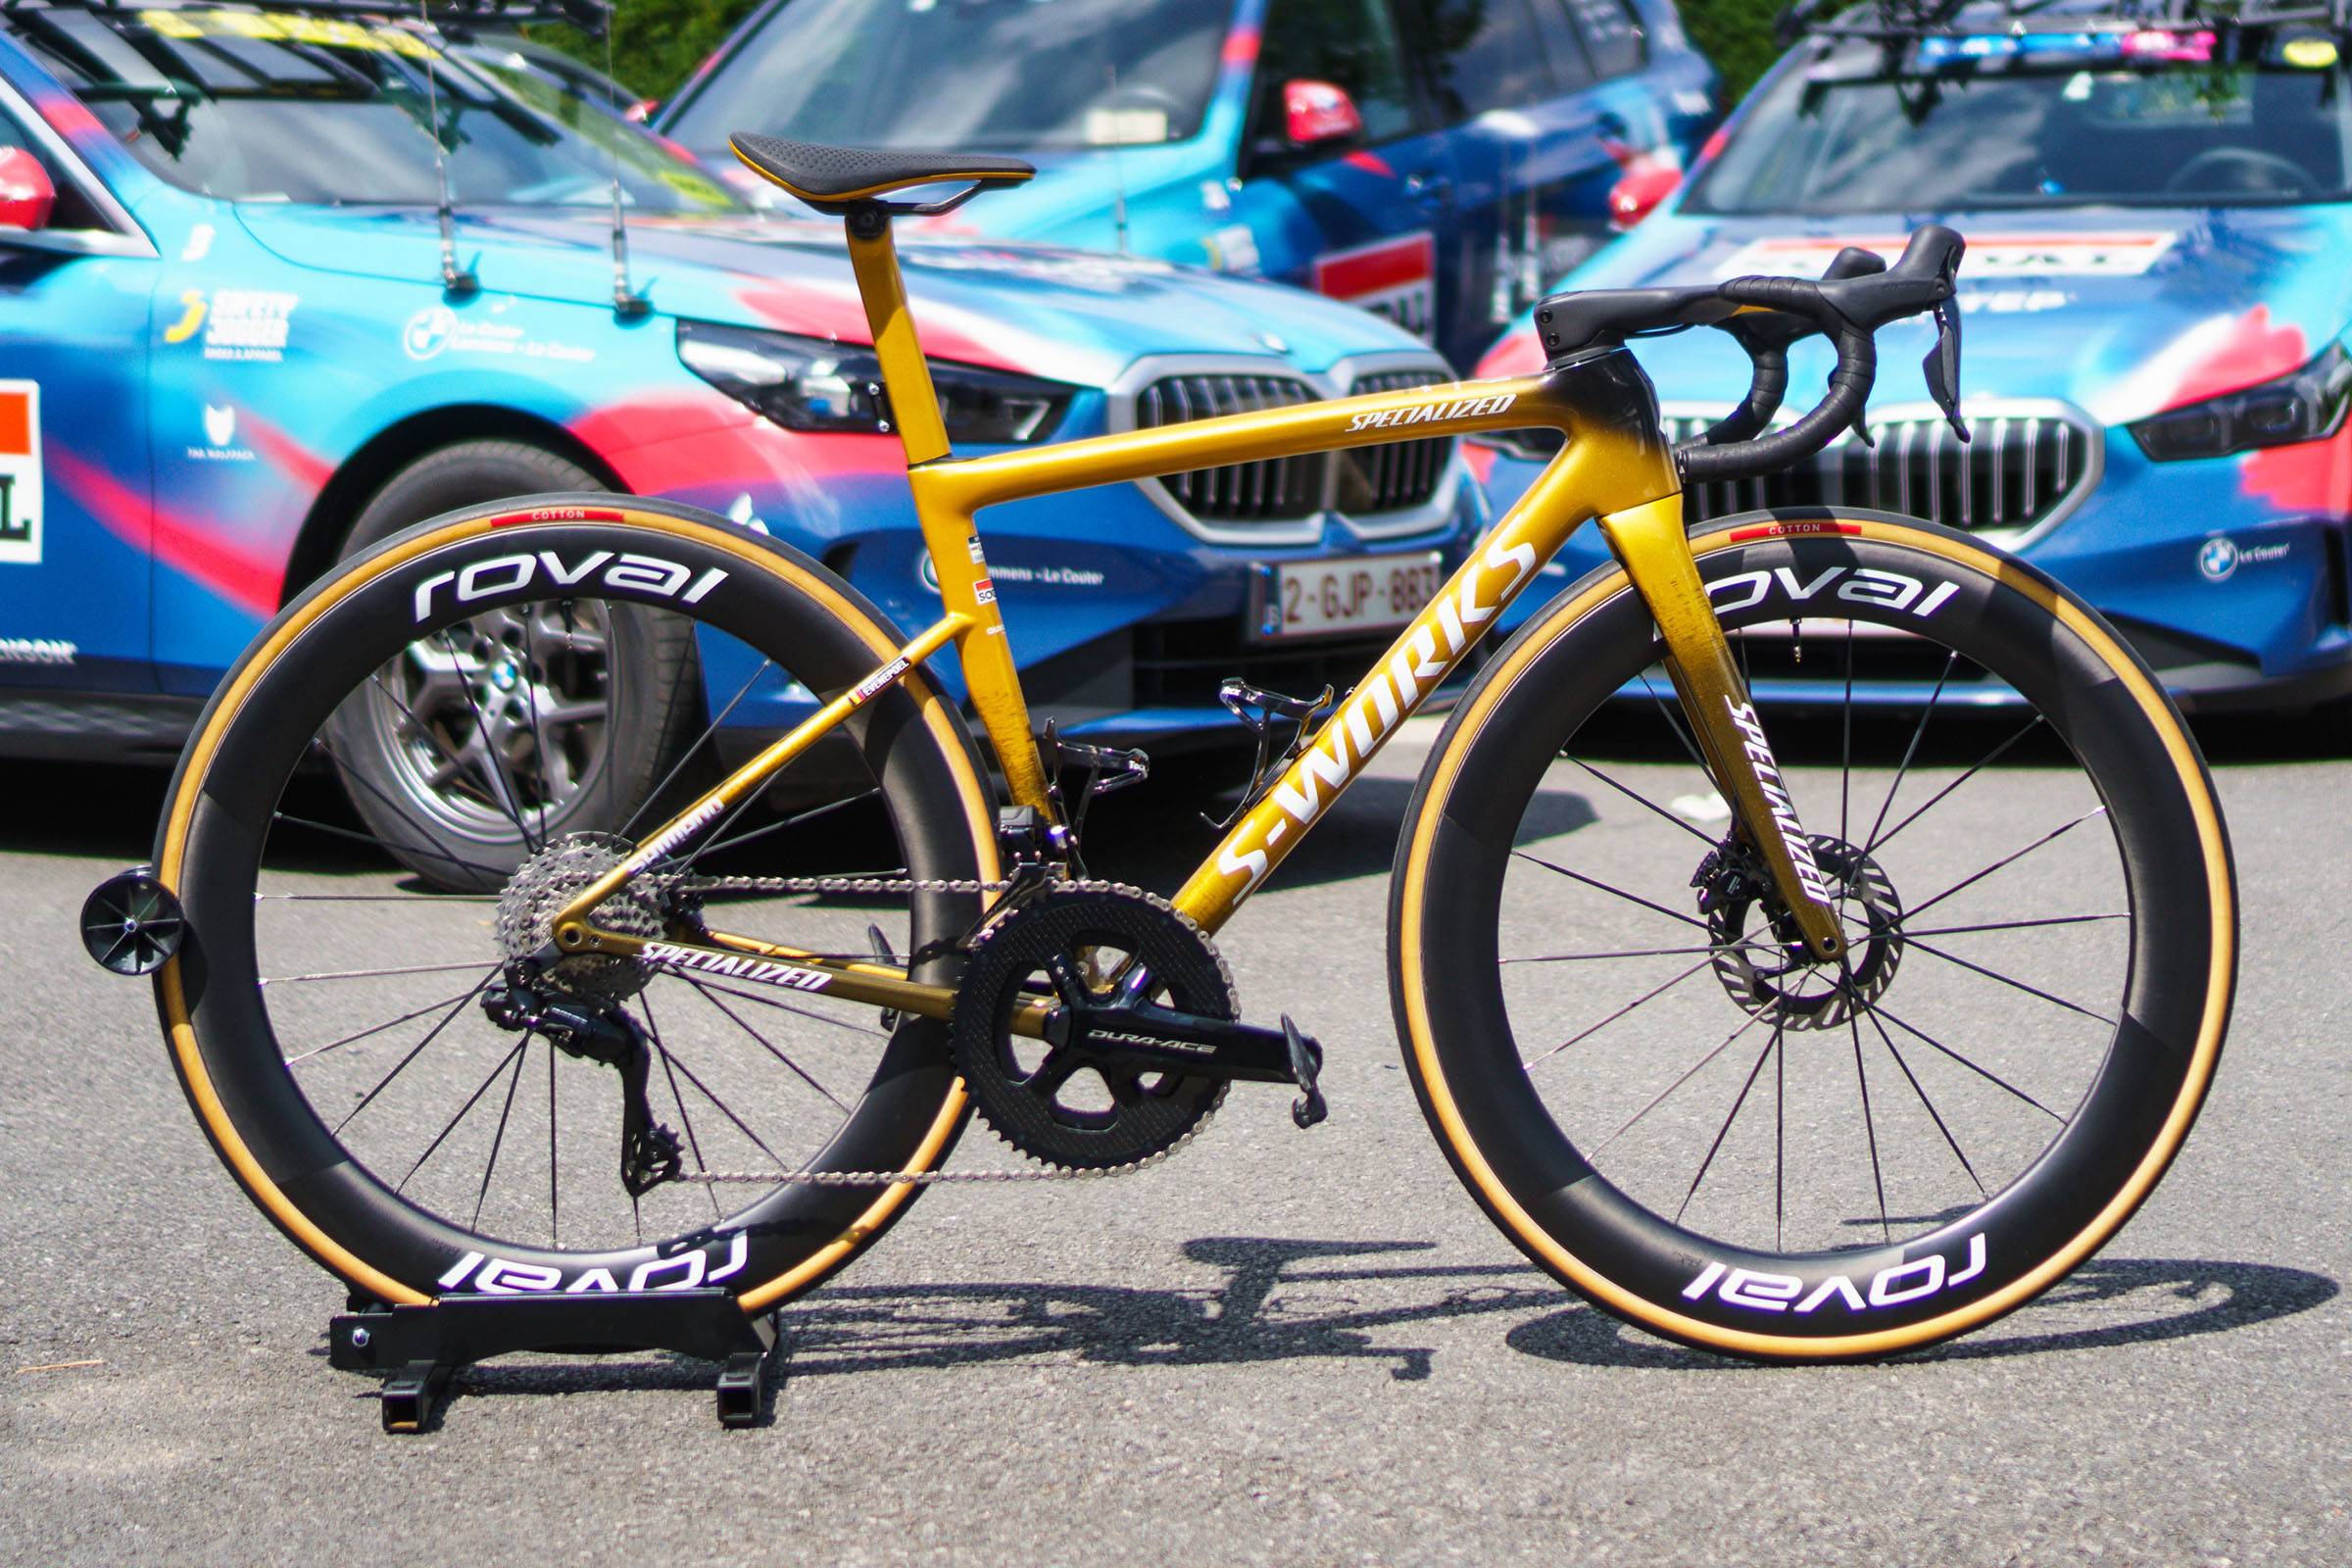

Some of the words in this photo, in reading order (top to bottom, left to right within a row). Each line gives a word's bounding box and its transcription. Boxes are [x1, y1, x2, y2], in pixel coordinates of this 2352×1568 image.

[1345, 393, 1517, 432] SPECIALIZED
[532, 510, 586, 520] COTTON
[1769, 523, 1821, 535] COTTON
[416, 550, 729, 623] roval
[988, 565, 1033, 581] mmens
[1043, 567, 1060, 582] Le
[1061, 568, 1104, 586] Couter
[1702, 566, 1960, 617] oval
[862, 659, 909, 698] EVENEPOEL
[1218, 513, 1537, 905] S-WORKS
[1724, 694, 1831, 905] SPECIALIZED
[626, 796, 725, 875] SHIMANO
[633, 941, 833, 991] SPECIALIZED
[1088, 1028, 1218, 1054] DURA-ACE
[1682, 1232, 1986, 1313] roval
